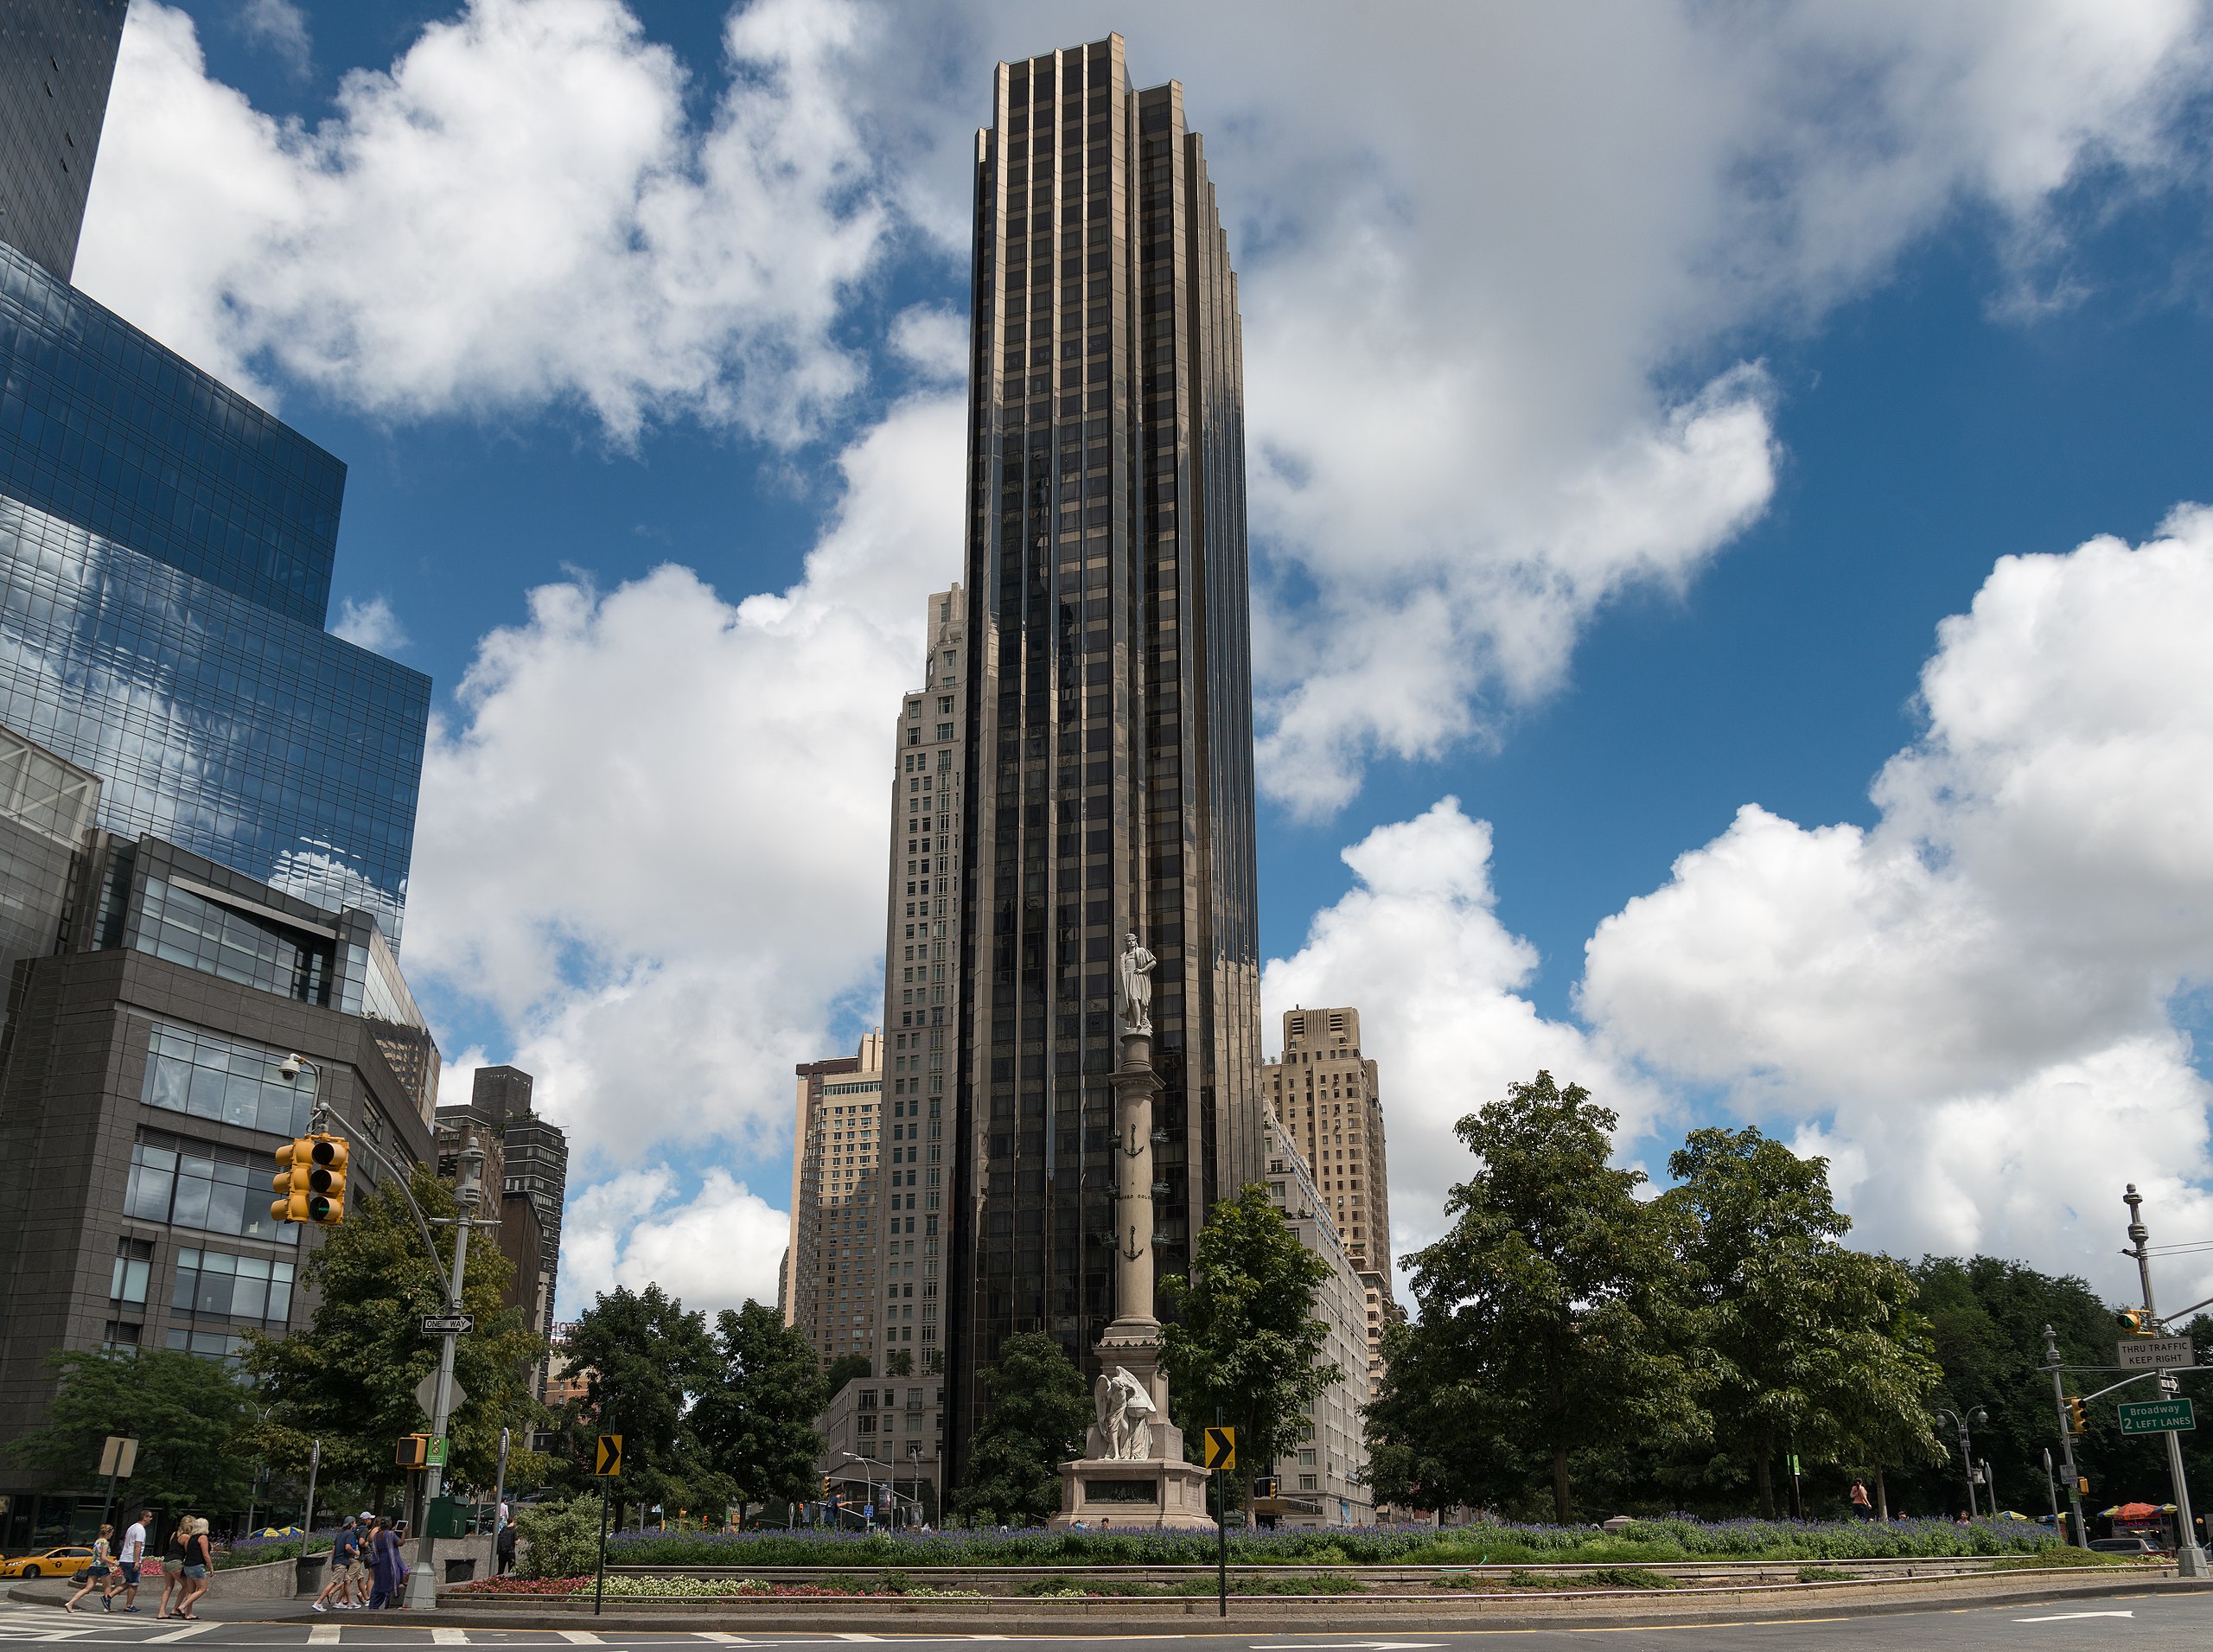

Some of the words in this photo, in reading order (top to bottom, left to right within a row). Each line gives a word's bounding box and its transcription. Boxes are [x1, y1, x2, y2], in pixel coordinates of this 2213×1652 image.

[2121, 1344, 2146, 1354] THRU
[2148, 1342, 2188, 1352] TRAFFIC
[2129, 1355, 2152, 1364] KEEP
[2156, 1354, 2183, 1363] RIGHT
[2129, 1405, 2179, 1416] Broadway
[2123, 1418, 2133, 1430] 2
[2135, 1419, 2157, 1429] LEFT
[2159, 1417, 2191, 1427] LANES
